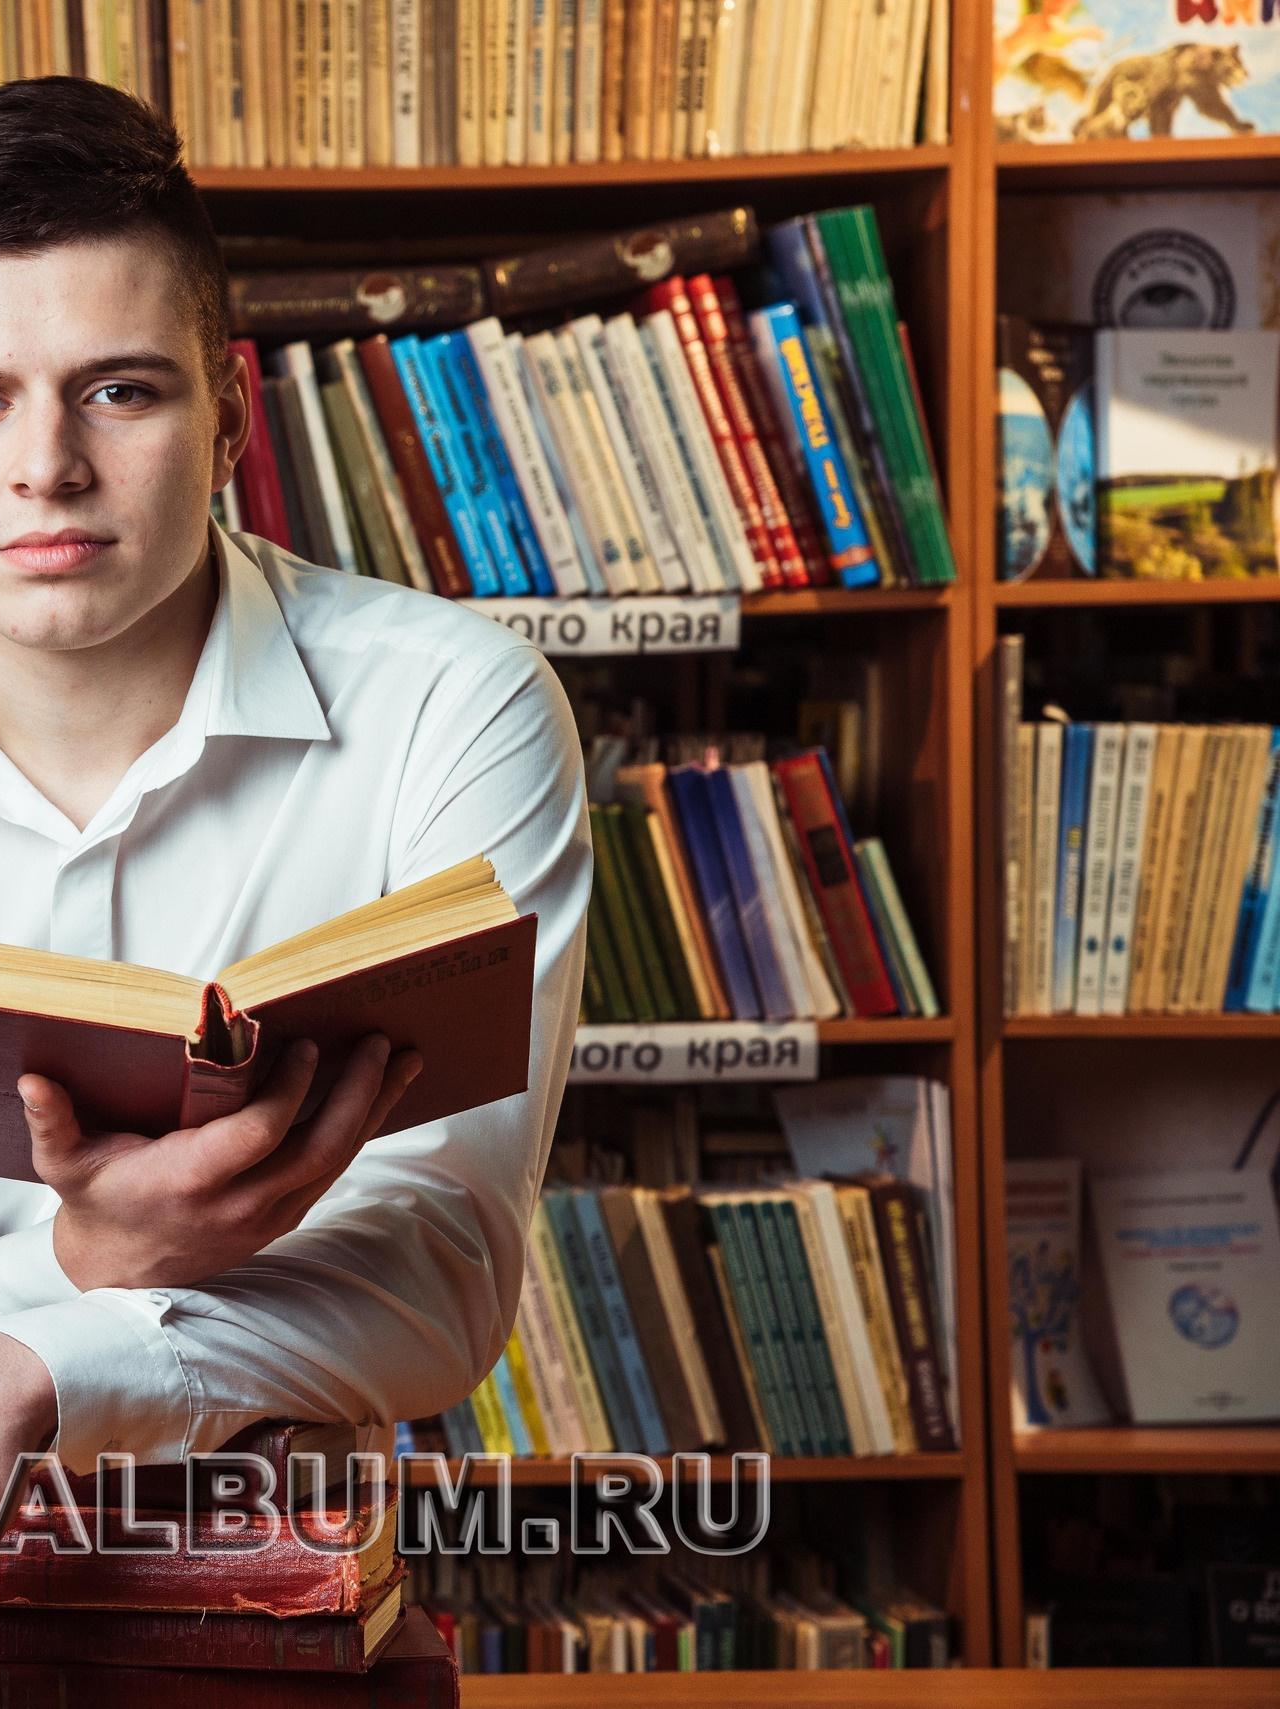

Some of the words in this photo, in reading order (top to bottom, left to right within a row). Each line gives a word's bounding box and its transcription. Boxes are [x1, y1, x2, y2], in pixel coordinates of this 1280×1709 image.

[493, 612, 586, 646] ого
[610, 610, 721, 654] края
[687, 1035, 799, 1074] края
